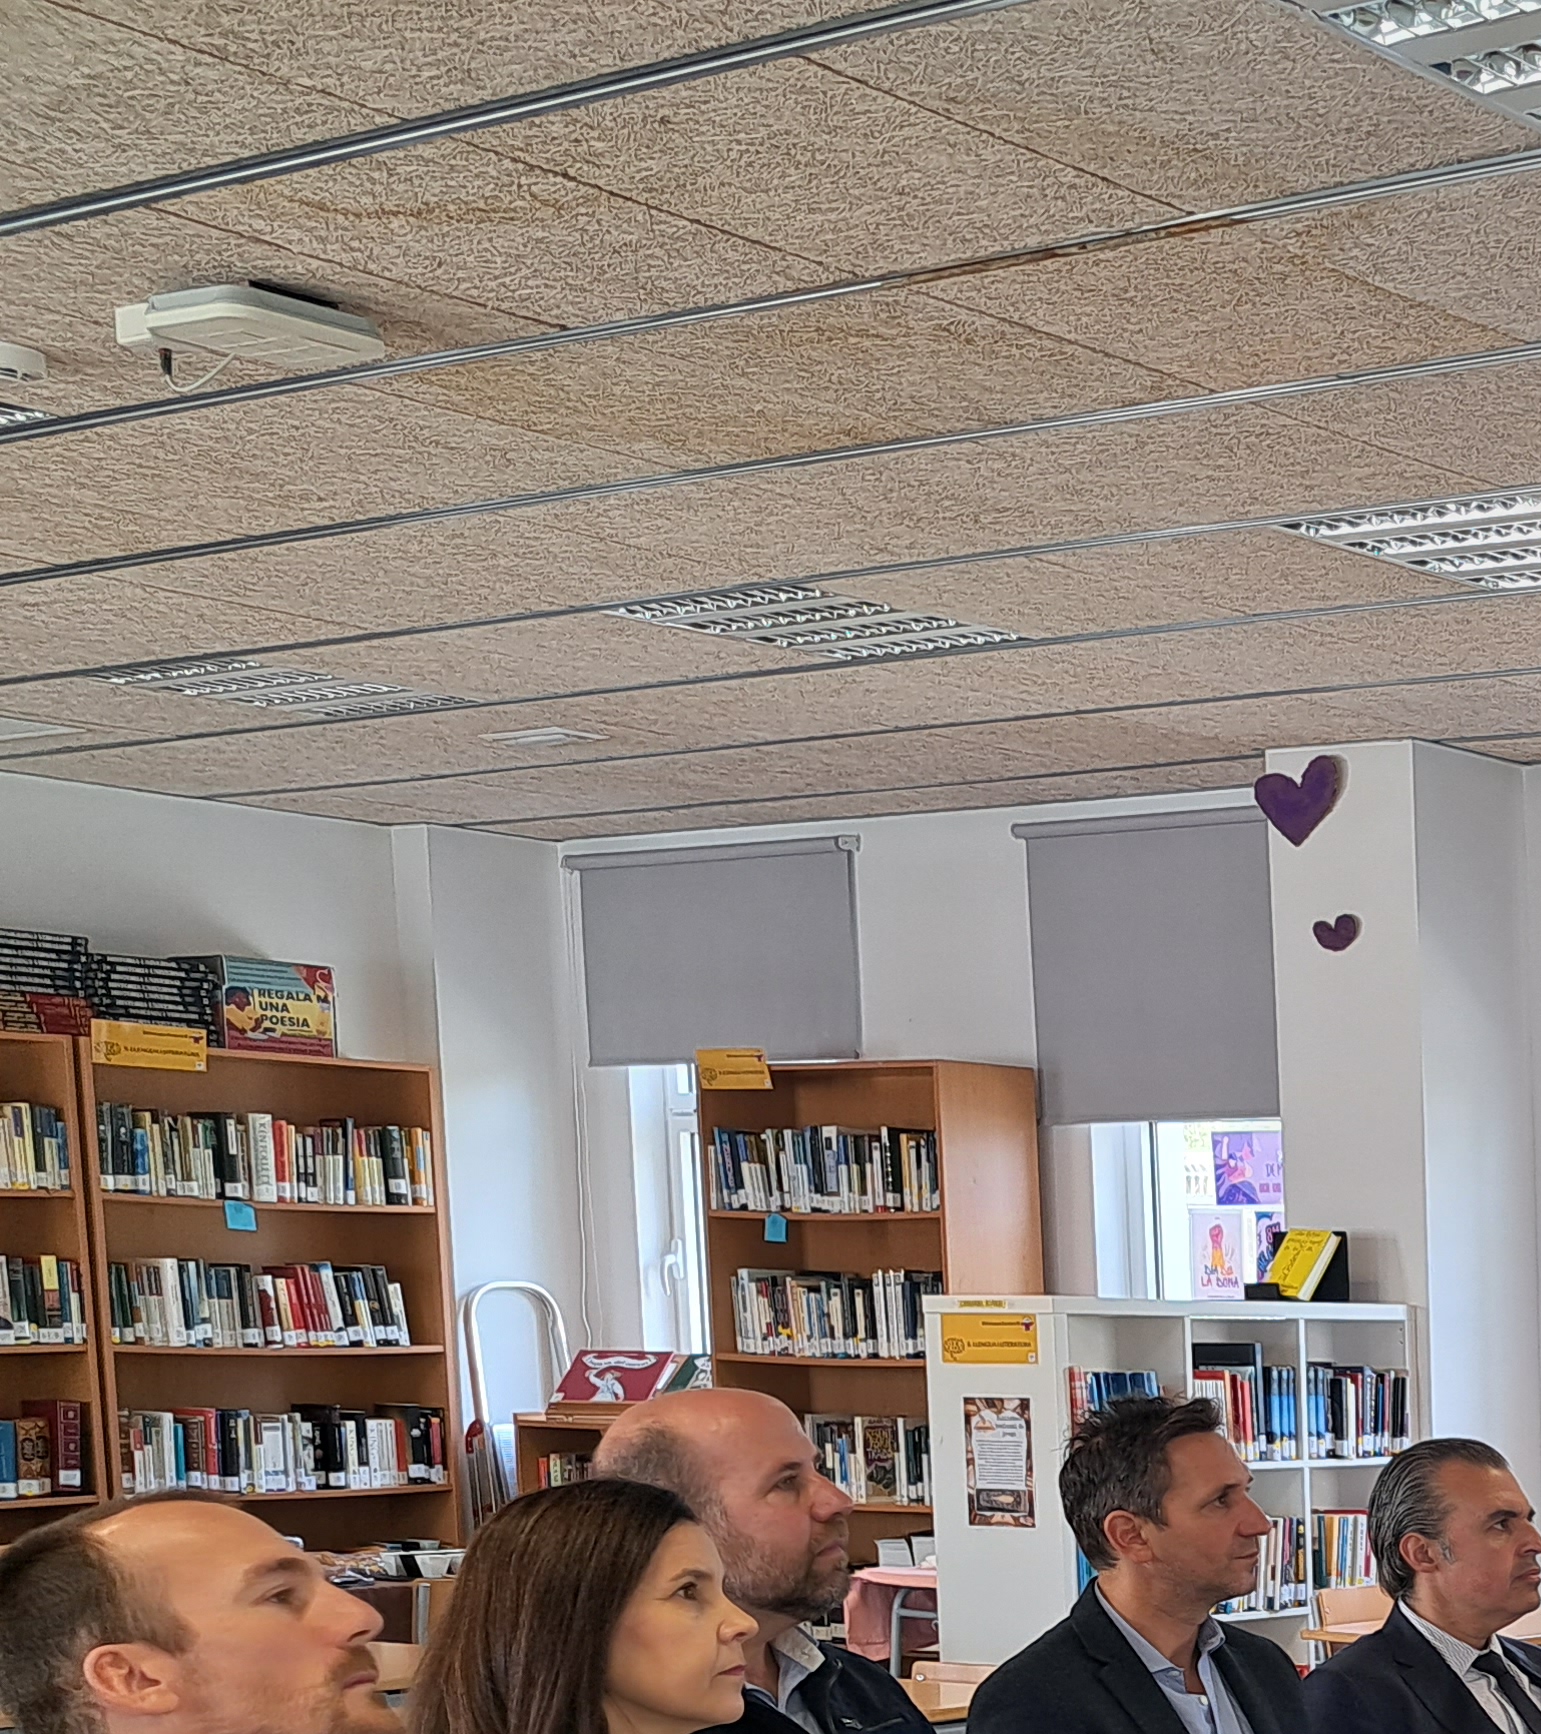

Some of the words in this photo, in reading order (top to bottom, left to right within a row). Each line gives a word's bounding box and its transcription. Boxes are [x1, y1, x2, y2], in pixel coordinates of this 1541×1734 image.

[257, 988, 314, 1003] REGALA
[258, 1000, 291, 1014] UNA
[260, 1013, 311, 1029] POESIA
[1200, 1275, 1213, 1288] LA
[1216, 1276, 1240, 1289] DONA
